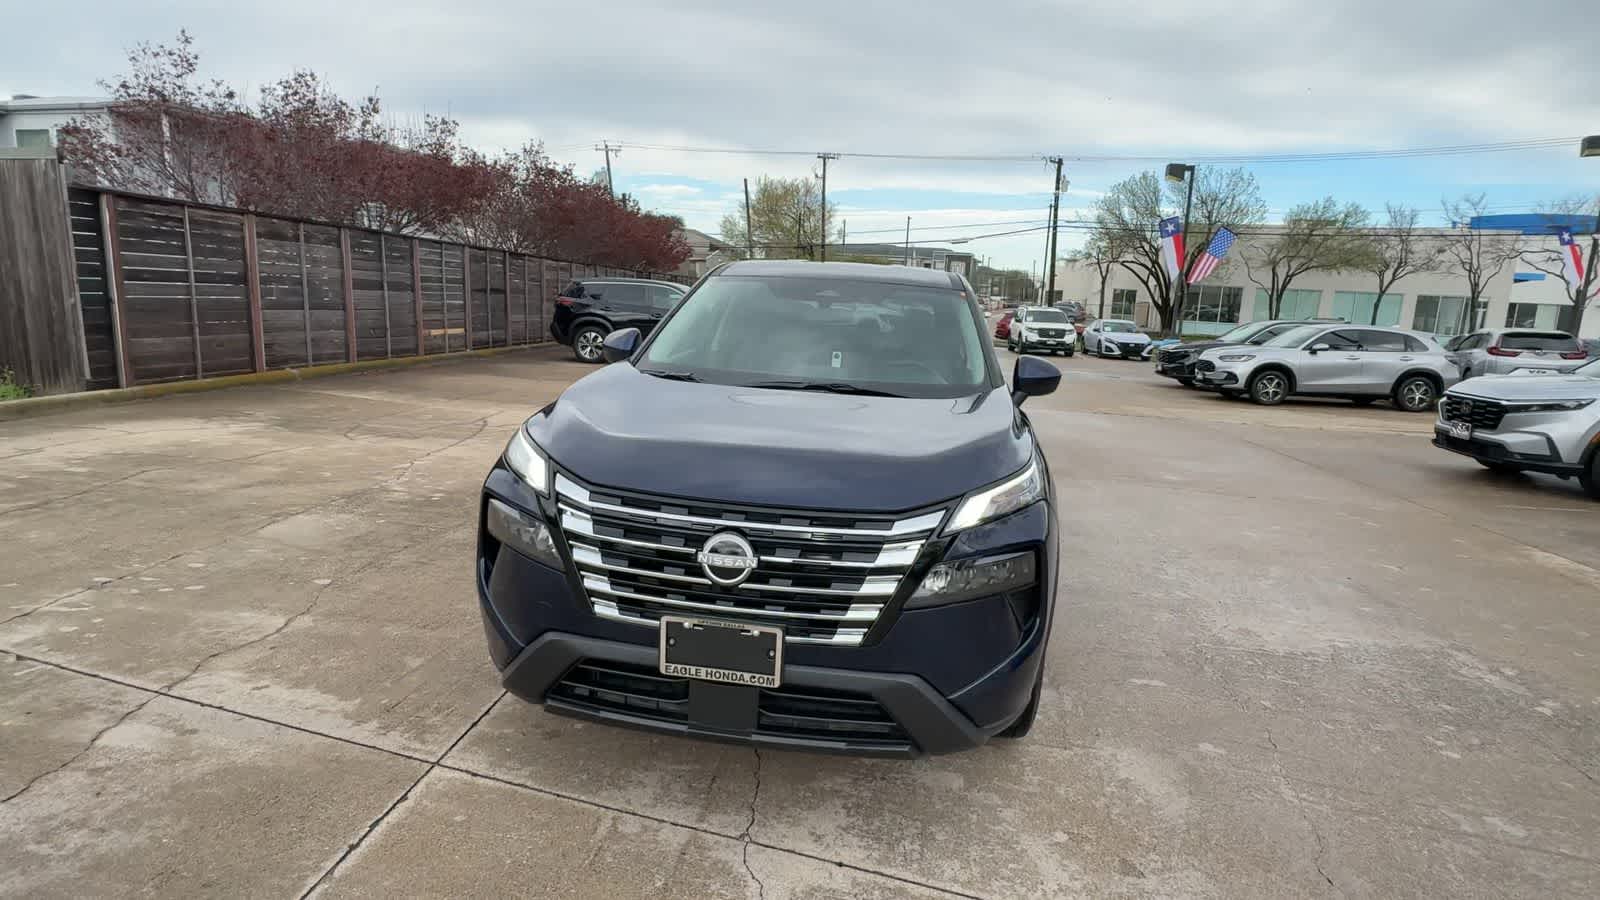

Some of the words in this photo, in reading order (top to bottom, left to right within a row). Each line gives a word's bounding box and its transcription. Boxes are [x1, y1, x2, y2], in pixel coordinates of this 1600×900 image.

[698, 553, 757, 568] NISSAN
[665, 664, 702, 677] EAGLE
[705, 669, 775, 686] HONDA.COM
